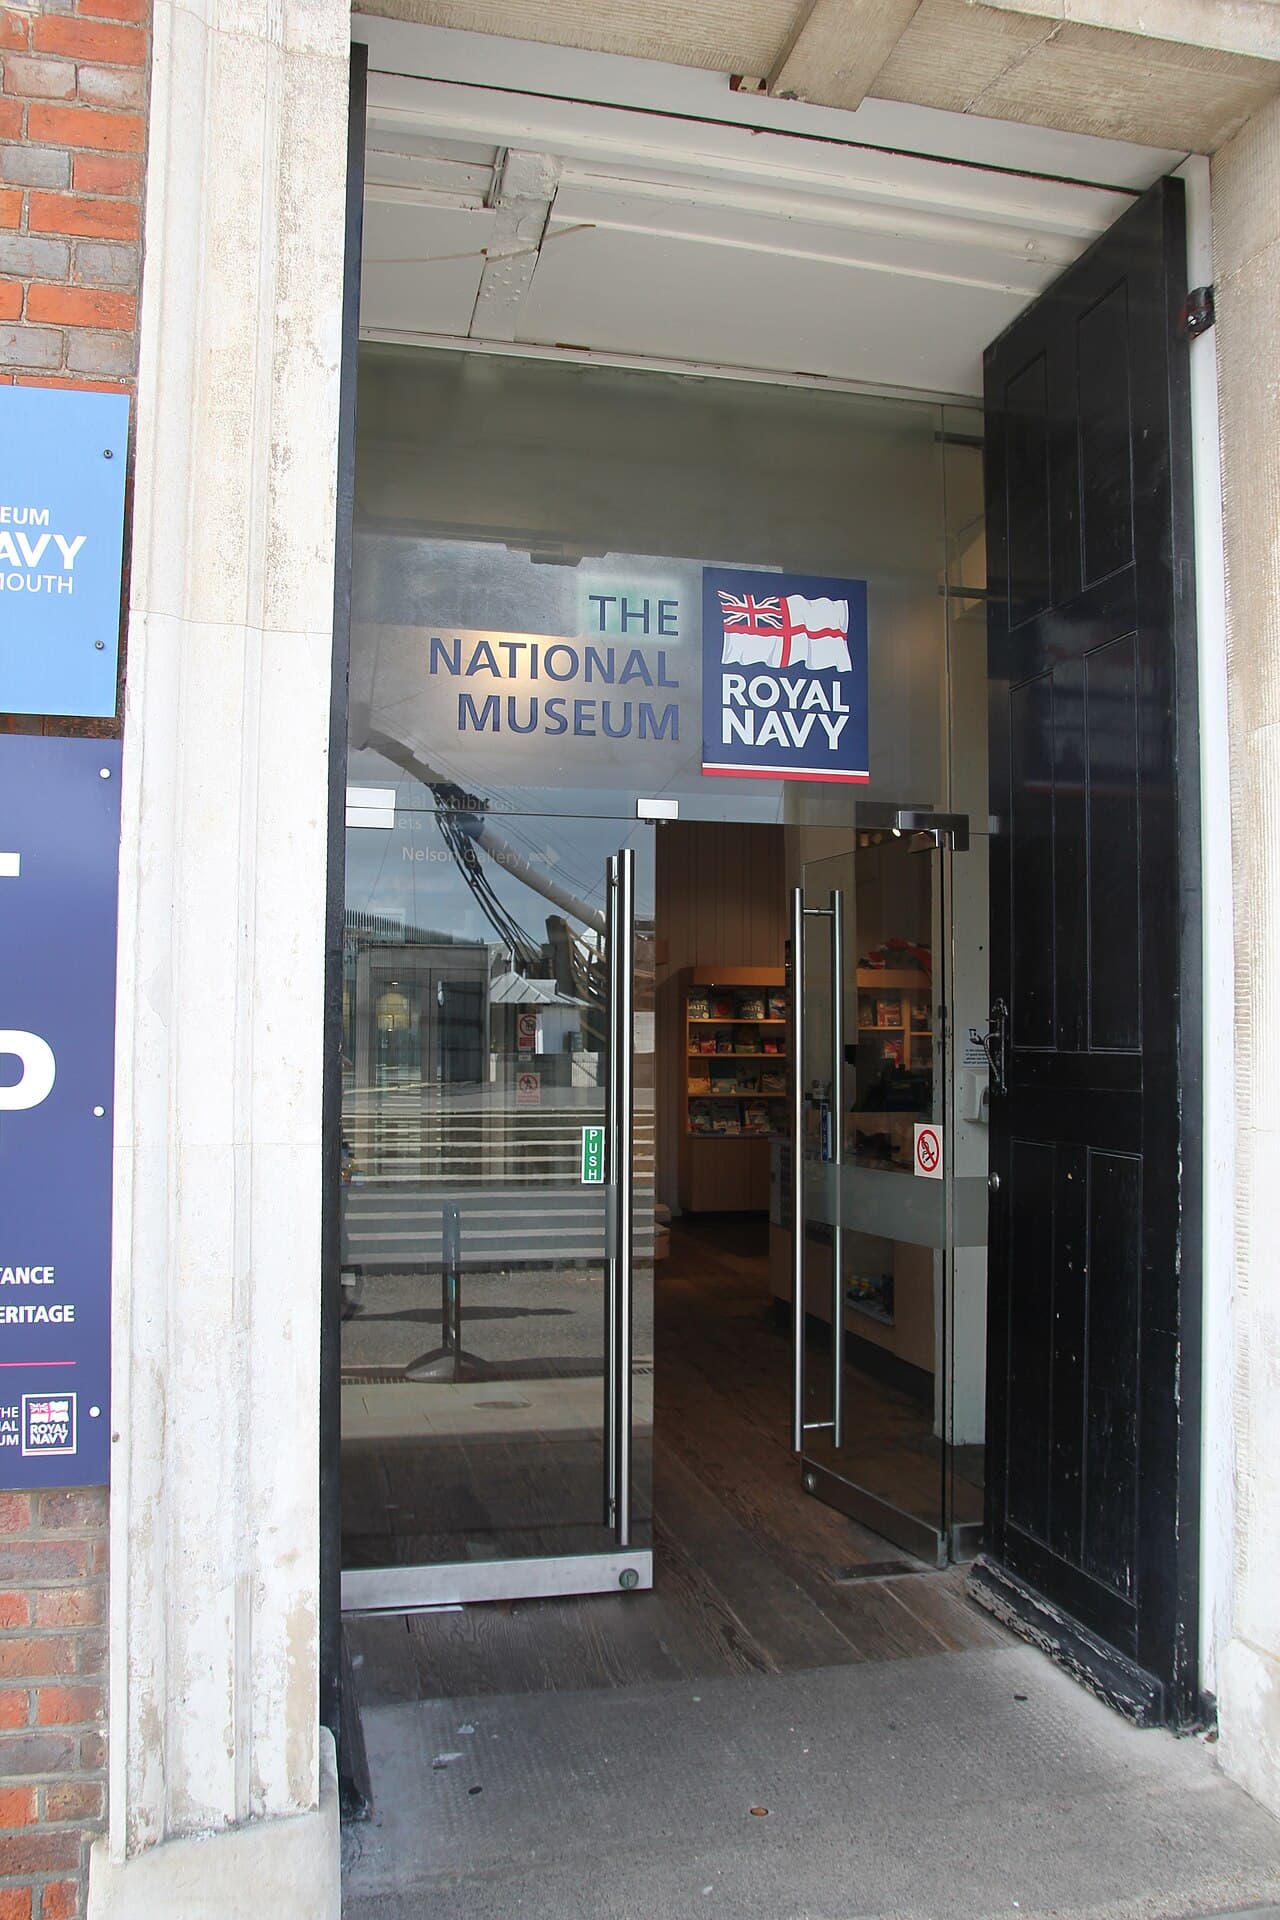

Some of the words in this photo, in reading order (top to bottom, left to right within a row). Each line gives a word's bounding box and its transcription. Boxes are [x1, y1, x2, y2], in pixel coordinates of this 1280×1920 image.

[0, 506, 49, 526] EUM
[0, 530, 88, 570] AVY
[588, 595, 679, 636] THE
[430, 638, 680, 688] NATIONAL
[722, 673, 850, 713] ROYAL
[458, 694, 680, 741] MUSEUM
[722, 707, 850, 750] NAVY
[402, 847, 459, 862] Nelson
[464, 848, 519, 867] Gallery
[588, 1129, 598, 1180] PUSH
[0, 1266, 55, 1285] ANCE
[0, 1420, 19, 1432] AL
[31, 1423, 69, 1435] ROYAL
[31, 1432, 68, 1445] NAVY
